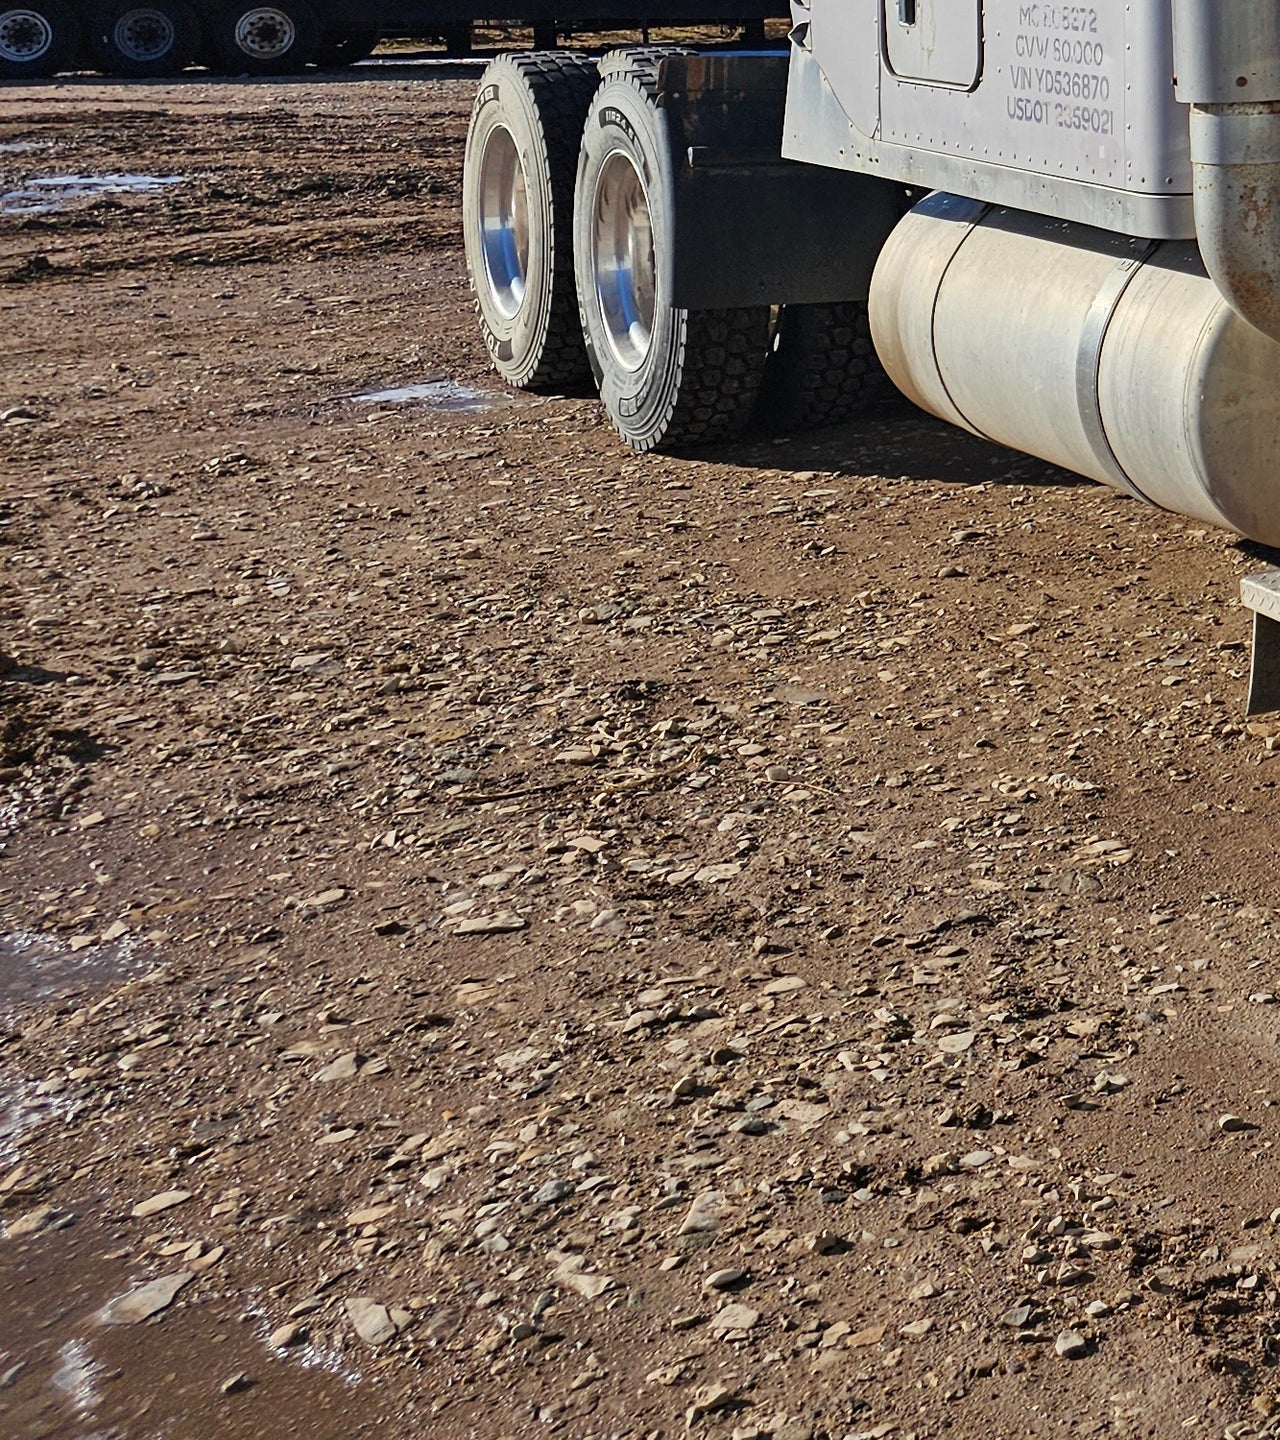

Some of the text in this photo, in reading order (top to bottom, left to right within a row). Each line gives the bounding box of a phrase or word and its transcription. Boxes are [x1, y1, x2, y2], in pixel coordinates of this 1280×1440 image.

[1015, 34, 1049, 59] GVW
[1009, 64, 1110, 102] VIN YD536870
[1006, 95, 1051, 125] USDOT
